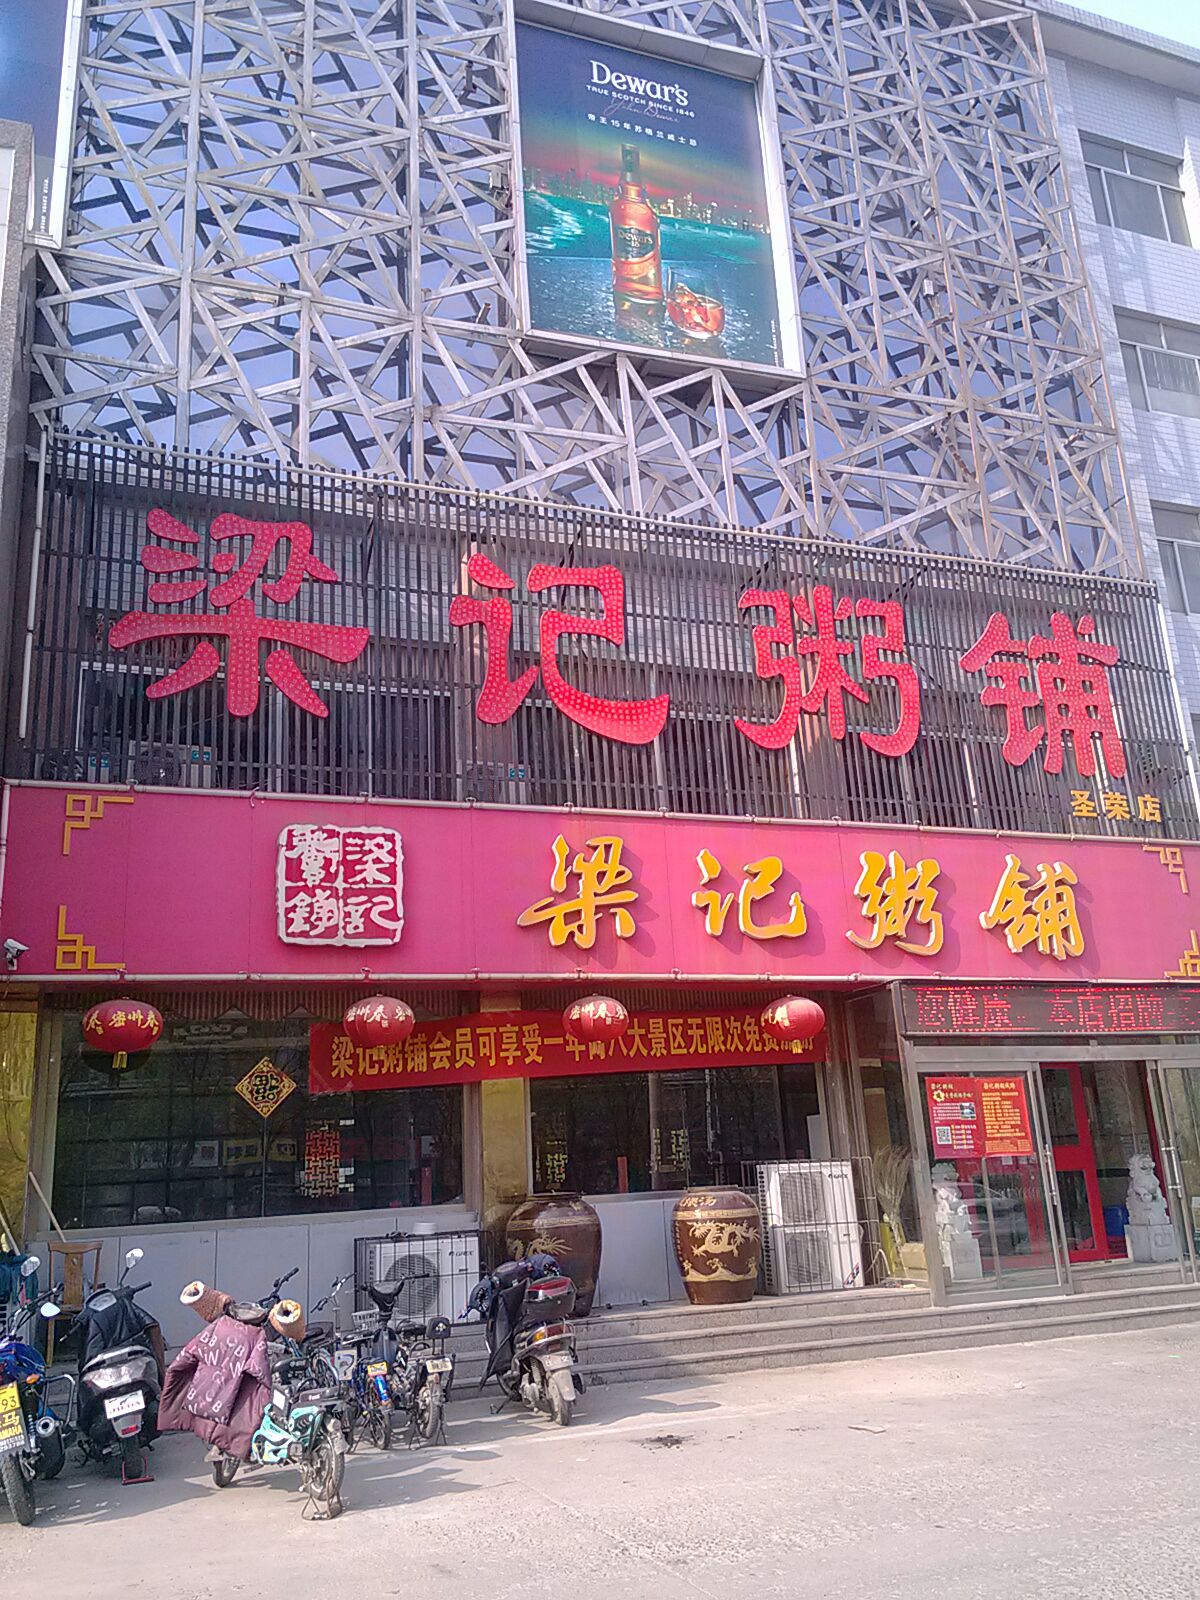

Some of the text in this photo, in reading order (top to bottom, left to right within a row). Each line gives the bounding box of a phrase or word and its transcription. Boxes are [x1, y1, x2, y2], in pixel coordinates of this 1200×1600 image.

[586, 84, 695, 118] TRUE SCOTCH SINCE 1846
[589, 60, 689, 106] Dewar's
[108, 507, 1127, 779] 梁记粥铺
[1070, 789, 1162, 822] 圣荣店
